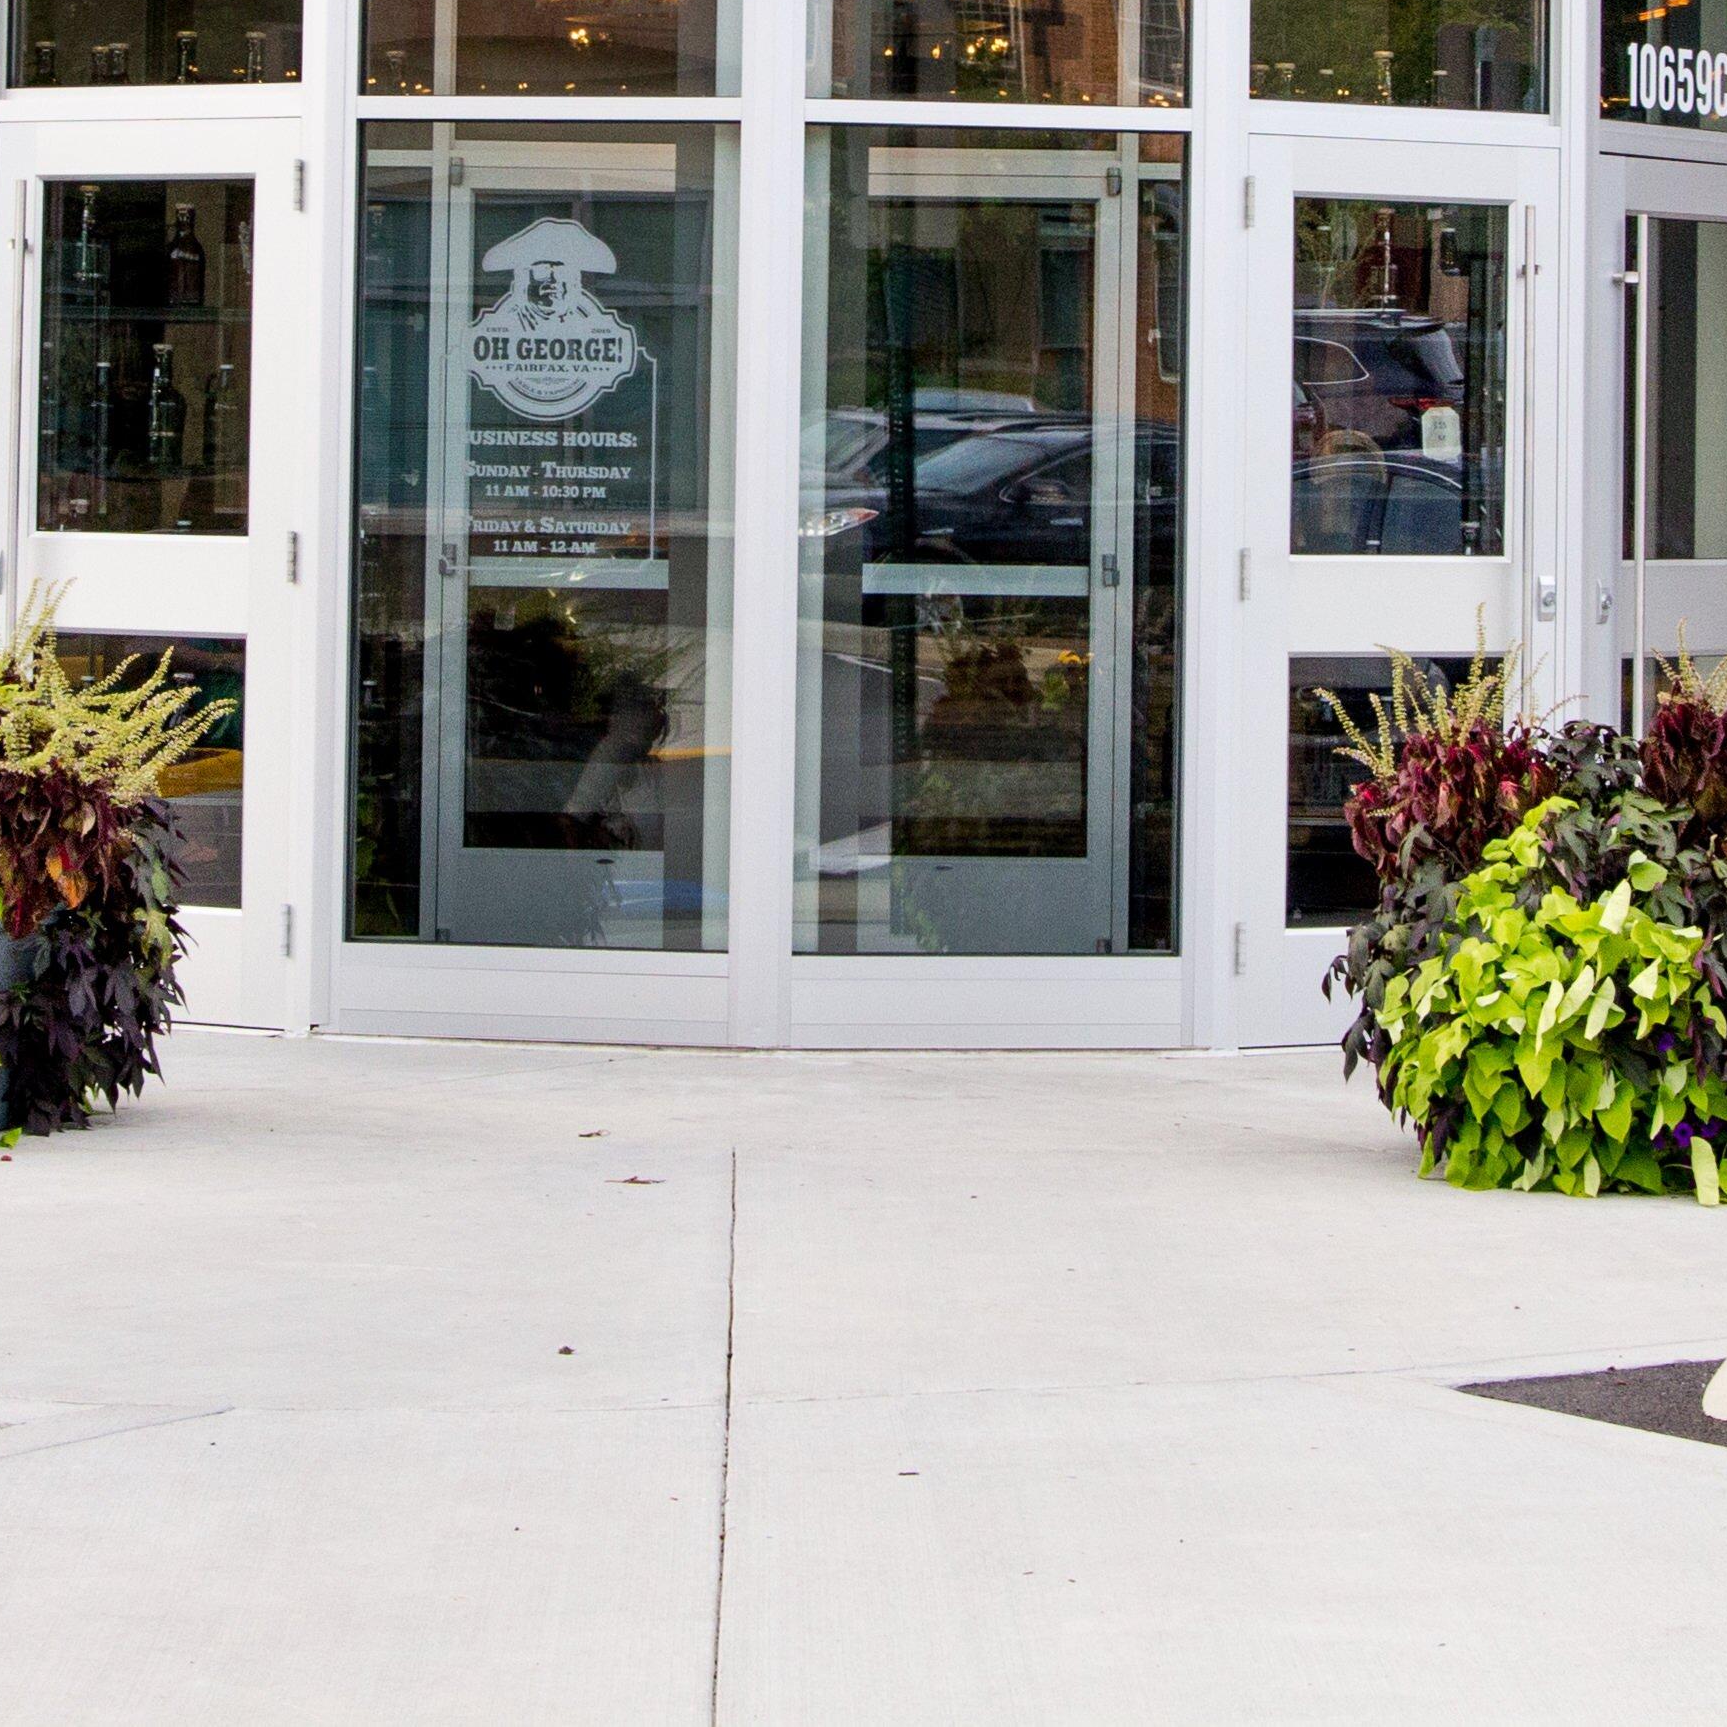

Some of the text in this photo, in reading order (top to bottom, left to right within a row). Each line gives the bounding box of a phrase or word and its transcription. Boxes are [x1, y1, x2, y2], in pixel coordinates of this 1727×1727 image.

[473, 335, 623, 363] OH GEORGE!
[563, 432, 638, 448] HOURS:
[465, 461, 530, 477] SUNDAY
[541, 461, 632, 479] THURSDAY
[485, 484, 499, 497] 11
[503, 485, 530, 497] AM
[542, 485, 580, 498] 10:30
[582, 486, 607, 498] PM
[524, 519, 536, 533] &
[540, 516, 631, 534] SATURDAY
[493, 540, 508, 552] 11
[512, 540, 538, 553] AM
[551, 540, 566, 553] 12
[569, 541, 596, 554] AM
